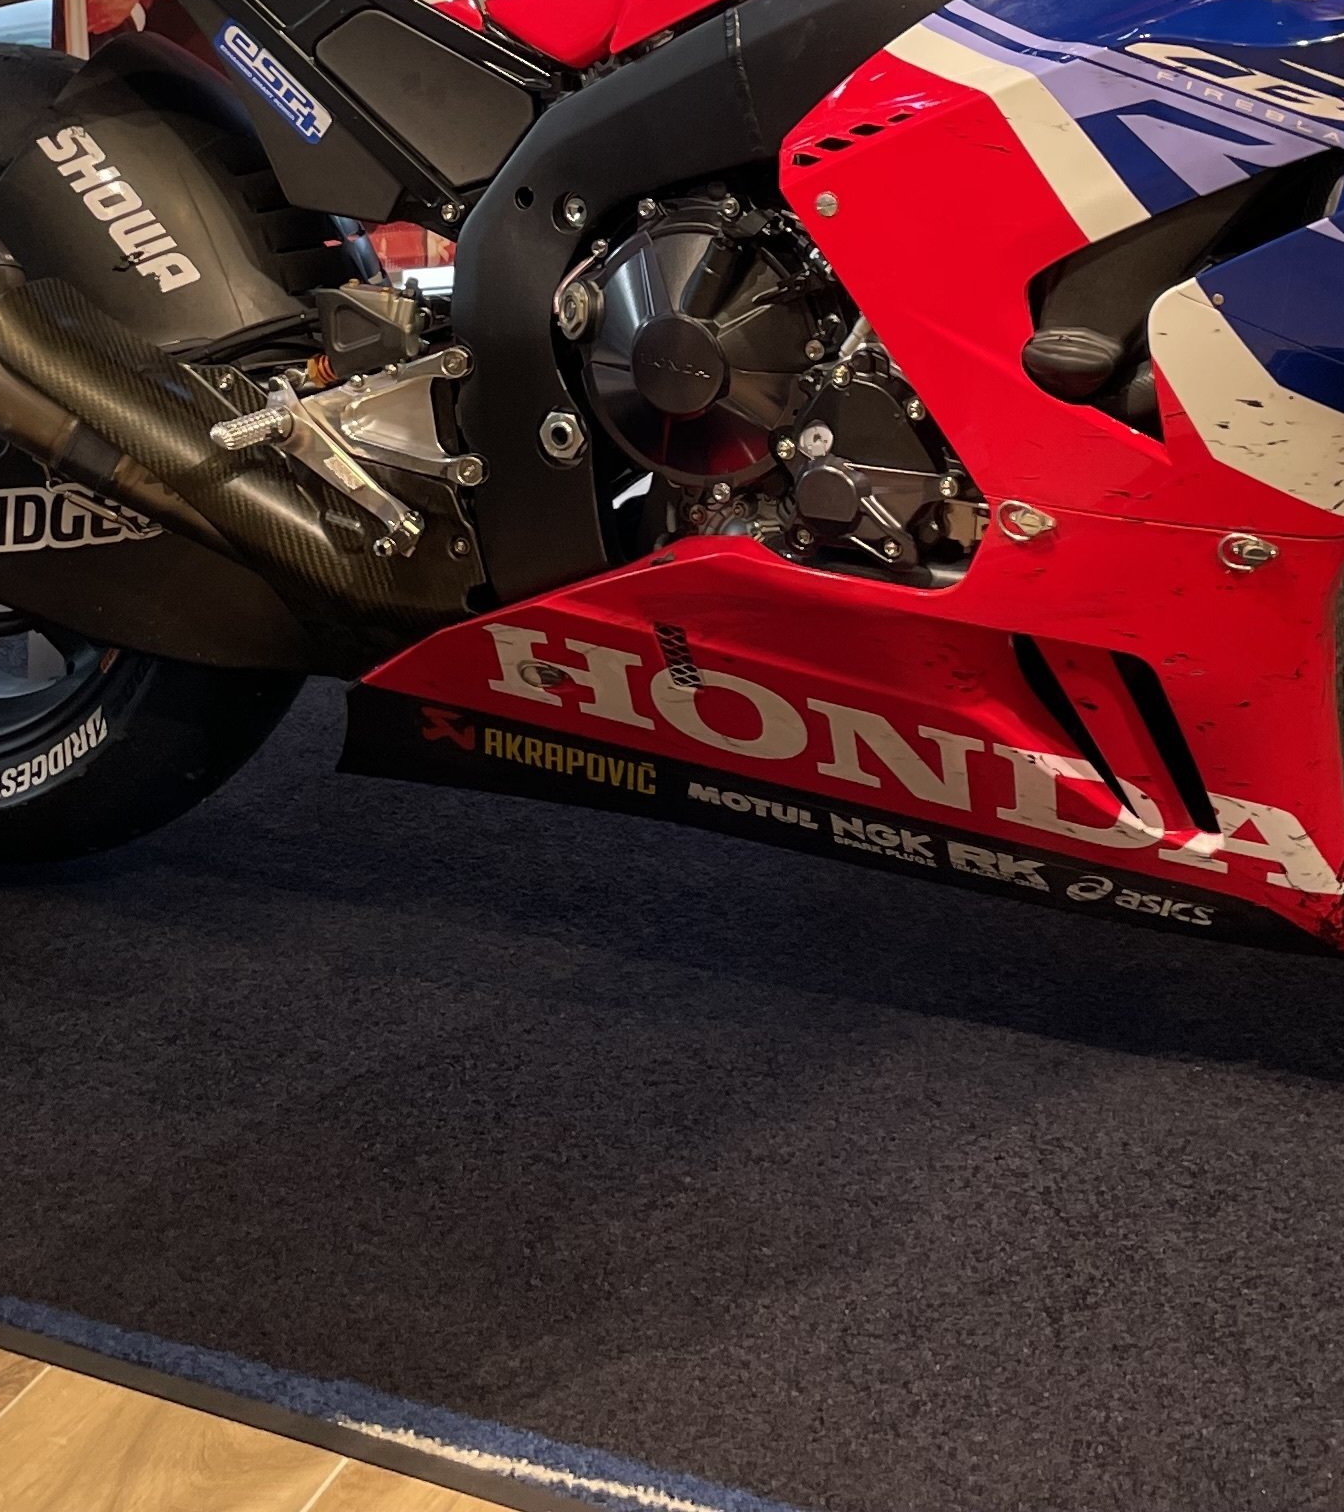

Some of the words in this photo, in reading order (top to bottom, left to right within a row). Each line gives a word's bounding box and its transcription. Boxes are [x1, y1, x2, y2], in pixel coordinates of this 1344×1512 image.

[35, 125, 202, 294] SHOWA
[484, 727, 657, 796] AKRAPOVIČ
[687, 781, 819, 830] MOTUL
[829, 812, 934, 858] NGK
[946, 840, 1050, 893] RK
[1114, 888, 1215, 926] asics
